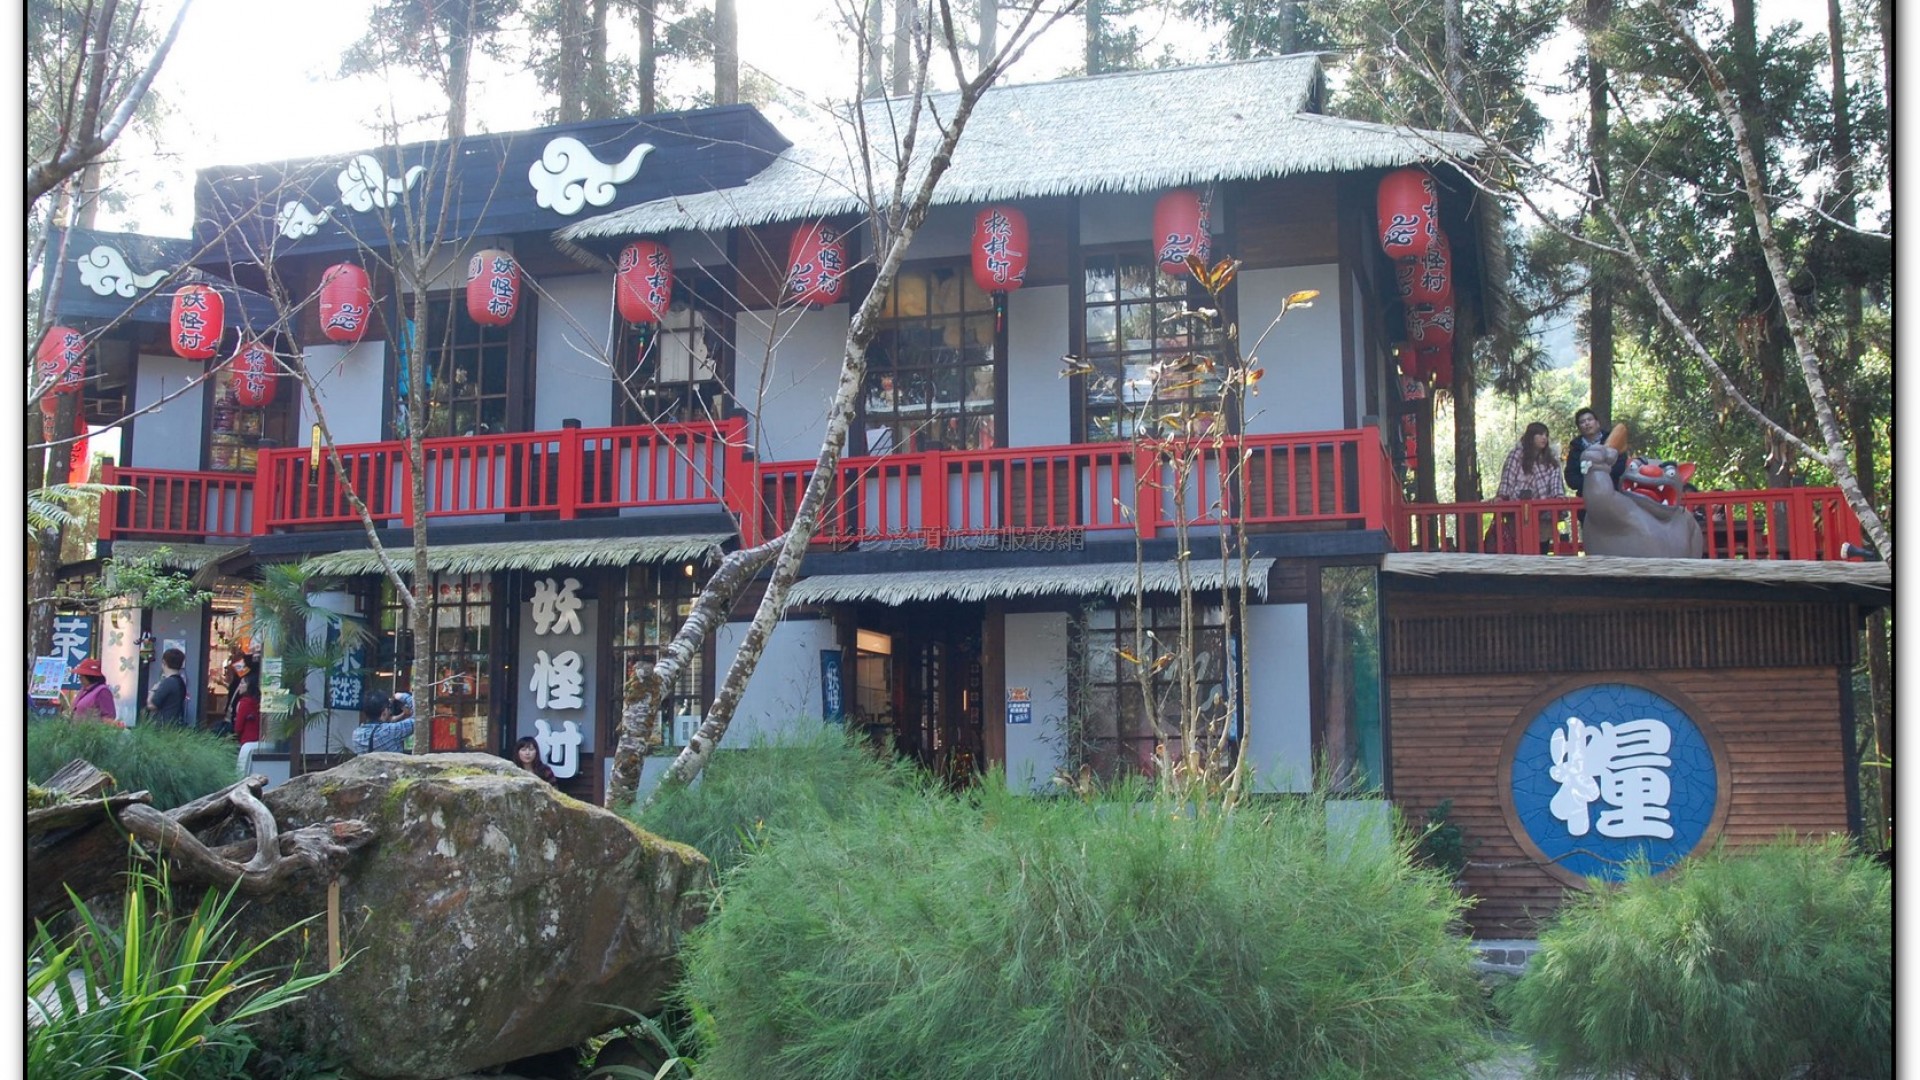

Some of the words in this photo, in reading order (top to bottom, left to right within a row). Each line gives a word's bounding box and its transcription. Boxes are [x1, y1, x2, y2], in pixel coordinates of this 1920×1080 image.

[487, 256, 515, 318] 妖怪村
[817, 226, 844, 295] 妖怪村
[178, 292, 208, 350] 妖怪村
[530, 577, 583, 779] 妖怪村
[1549, 716, 1674, 839] 糧
